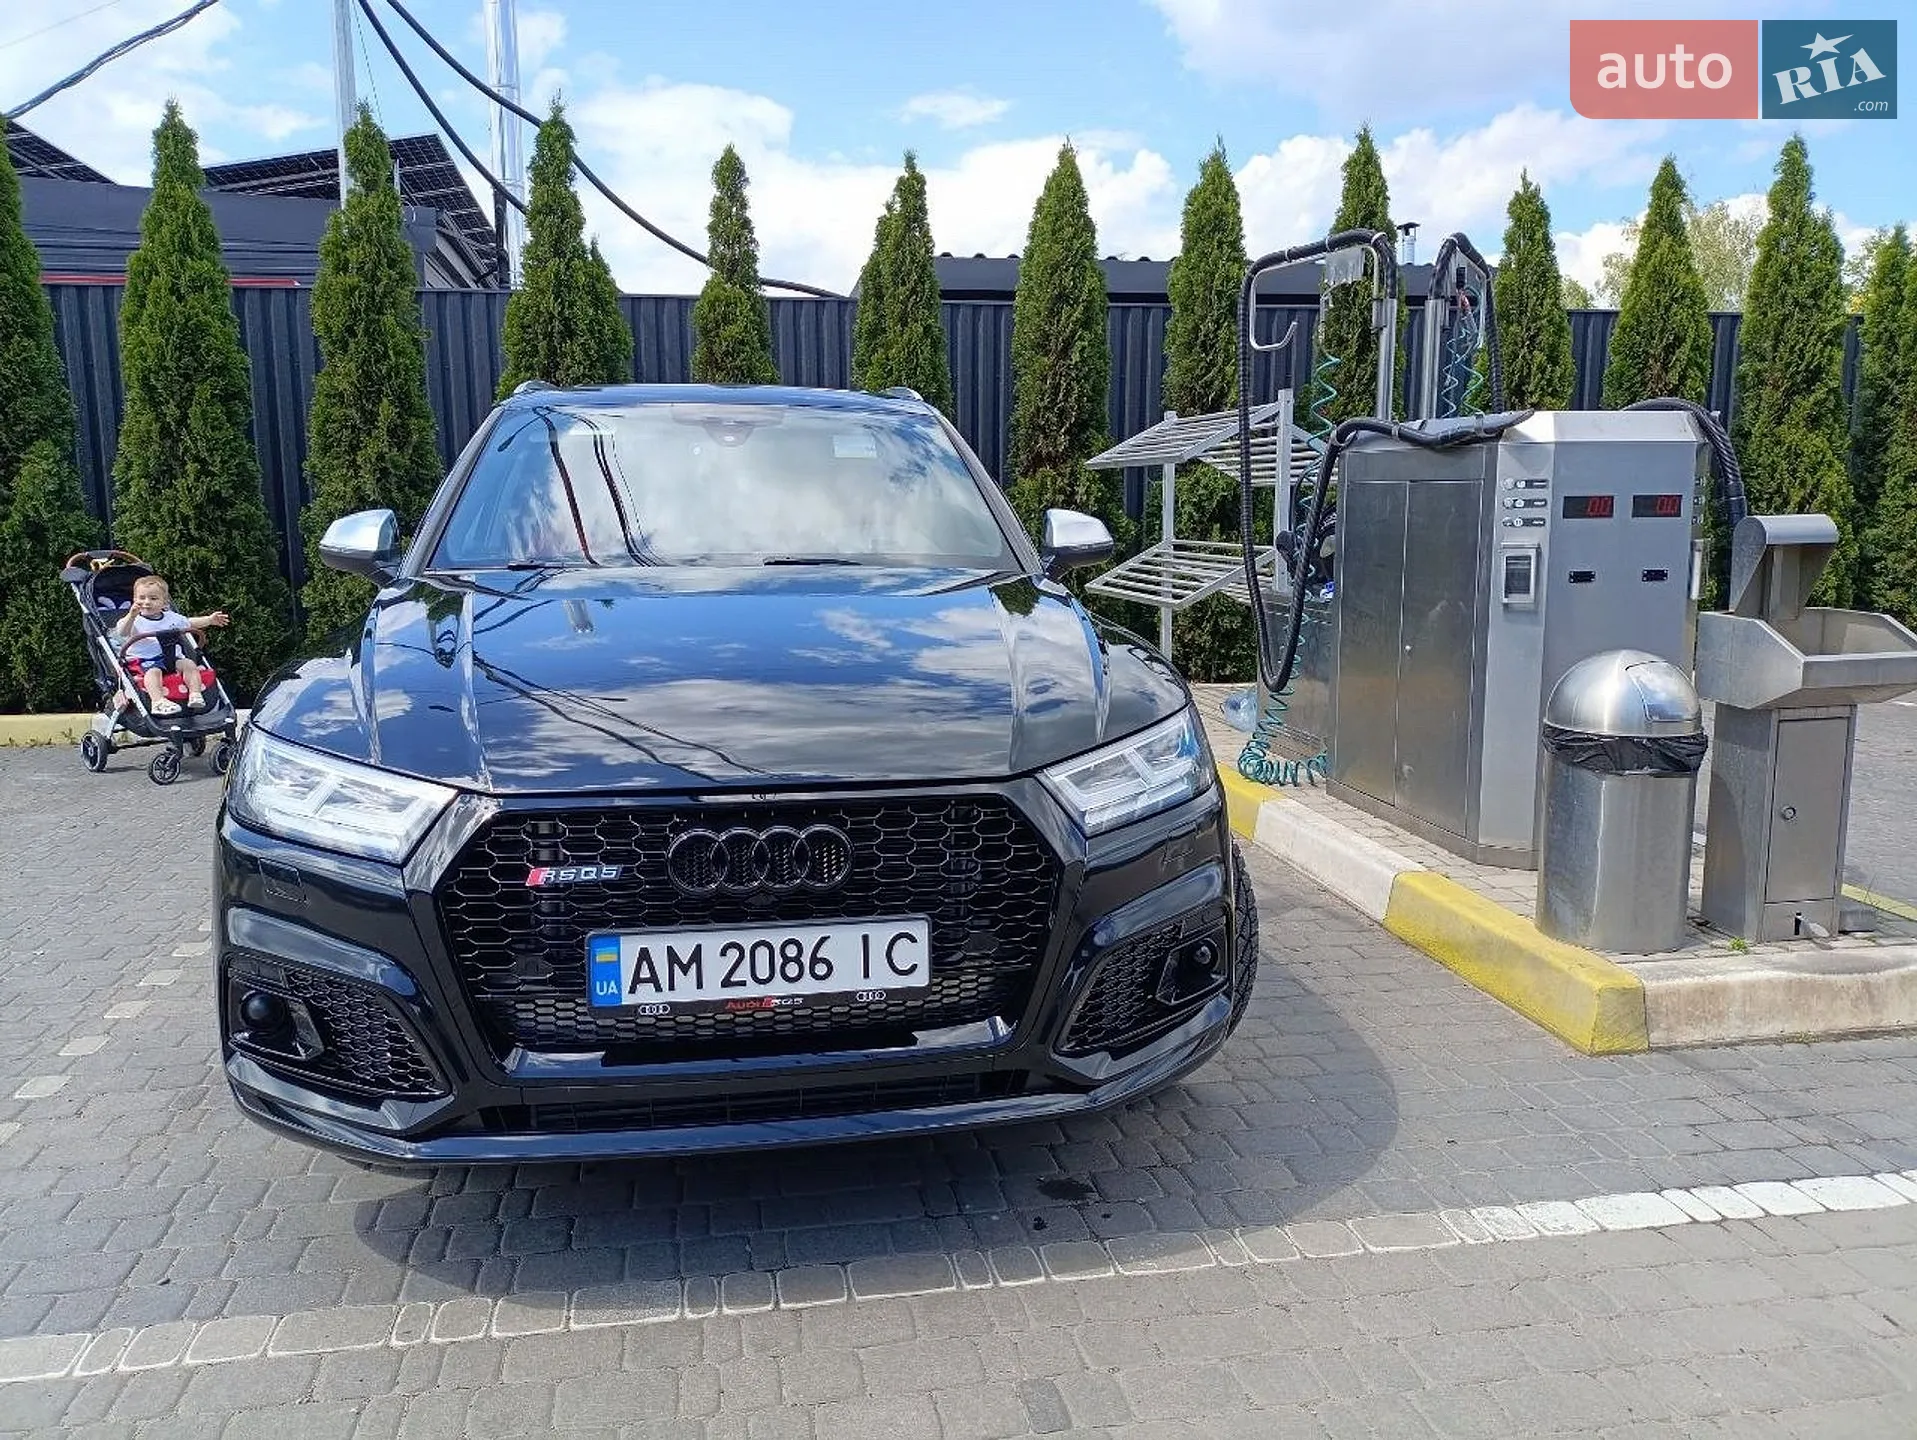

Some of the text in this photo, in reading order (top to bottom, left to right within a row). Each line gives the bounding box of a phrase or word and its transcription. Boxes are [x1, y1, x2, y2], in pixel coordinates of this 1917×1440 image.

[538, 867, 618, 882] RSQ5
[628, 931, 918, 994] AM 2086 IC
[596, 981, 618, 996] UA
